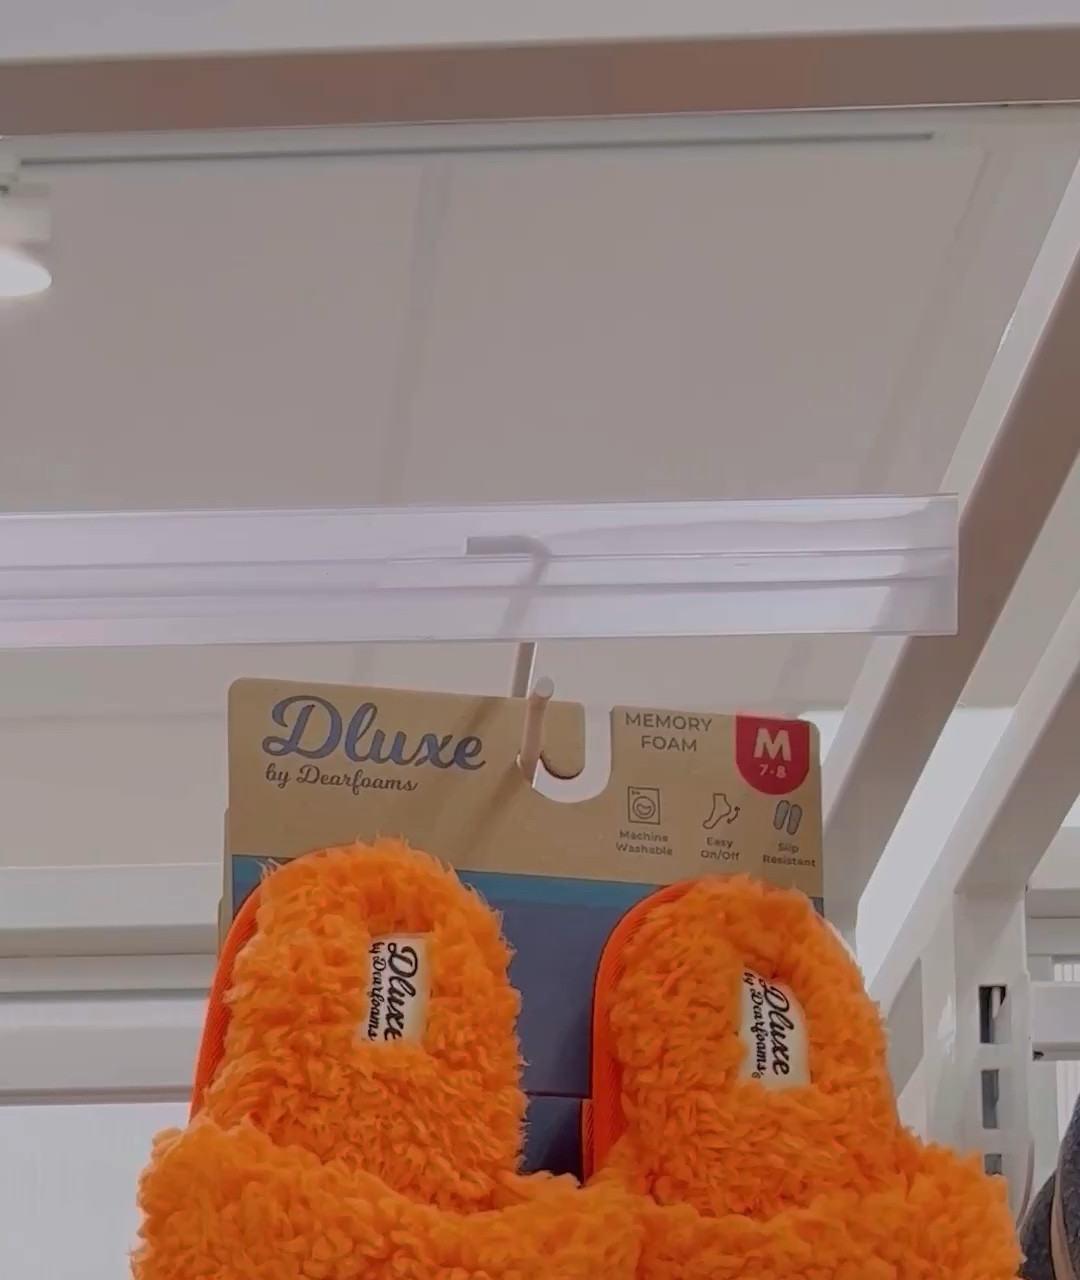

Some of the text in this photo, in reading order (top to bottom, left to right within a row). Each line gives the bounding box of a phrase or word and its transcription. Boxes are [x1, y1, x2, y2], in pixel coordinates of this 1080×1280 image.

[625, 712, 712, 733] MEMORY
[262, 695, 486, 771] Dluxe
[641, 735, 697, 751] FOAM
[753, 728, 793, 761] M
[759, 764, 786, 779] 7-8
[266, 764, 420, 795] by Dearfoams
[619, 831, 668, 843] Machine
[706, 837, 733, 849] Easy
[615, 842, 672, 856] Washable
[700, 850, 740, 861] On/Off
[778, 843, 799, 854] Slip
[762, 854, 816, 867] Resistant
[383, 941, 418, 1041] Dluxe
[758, 975, 796, 1077] Dluxe
